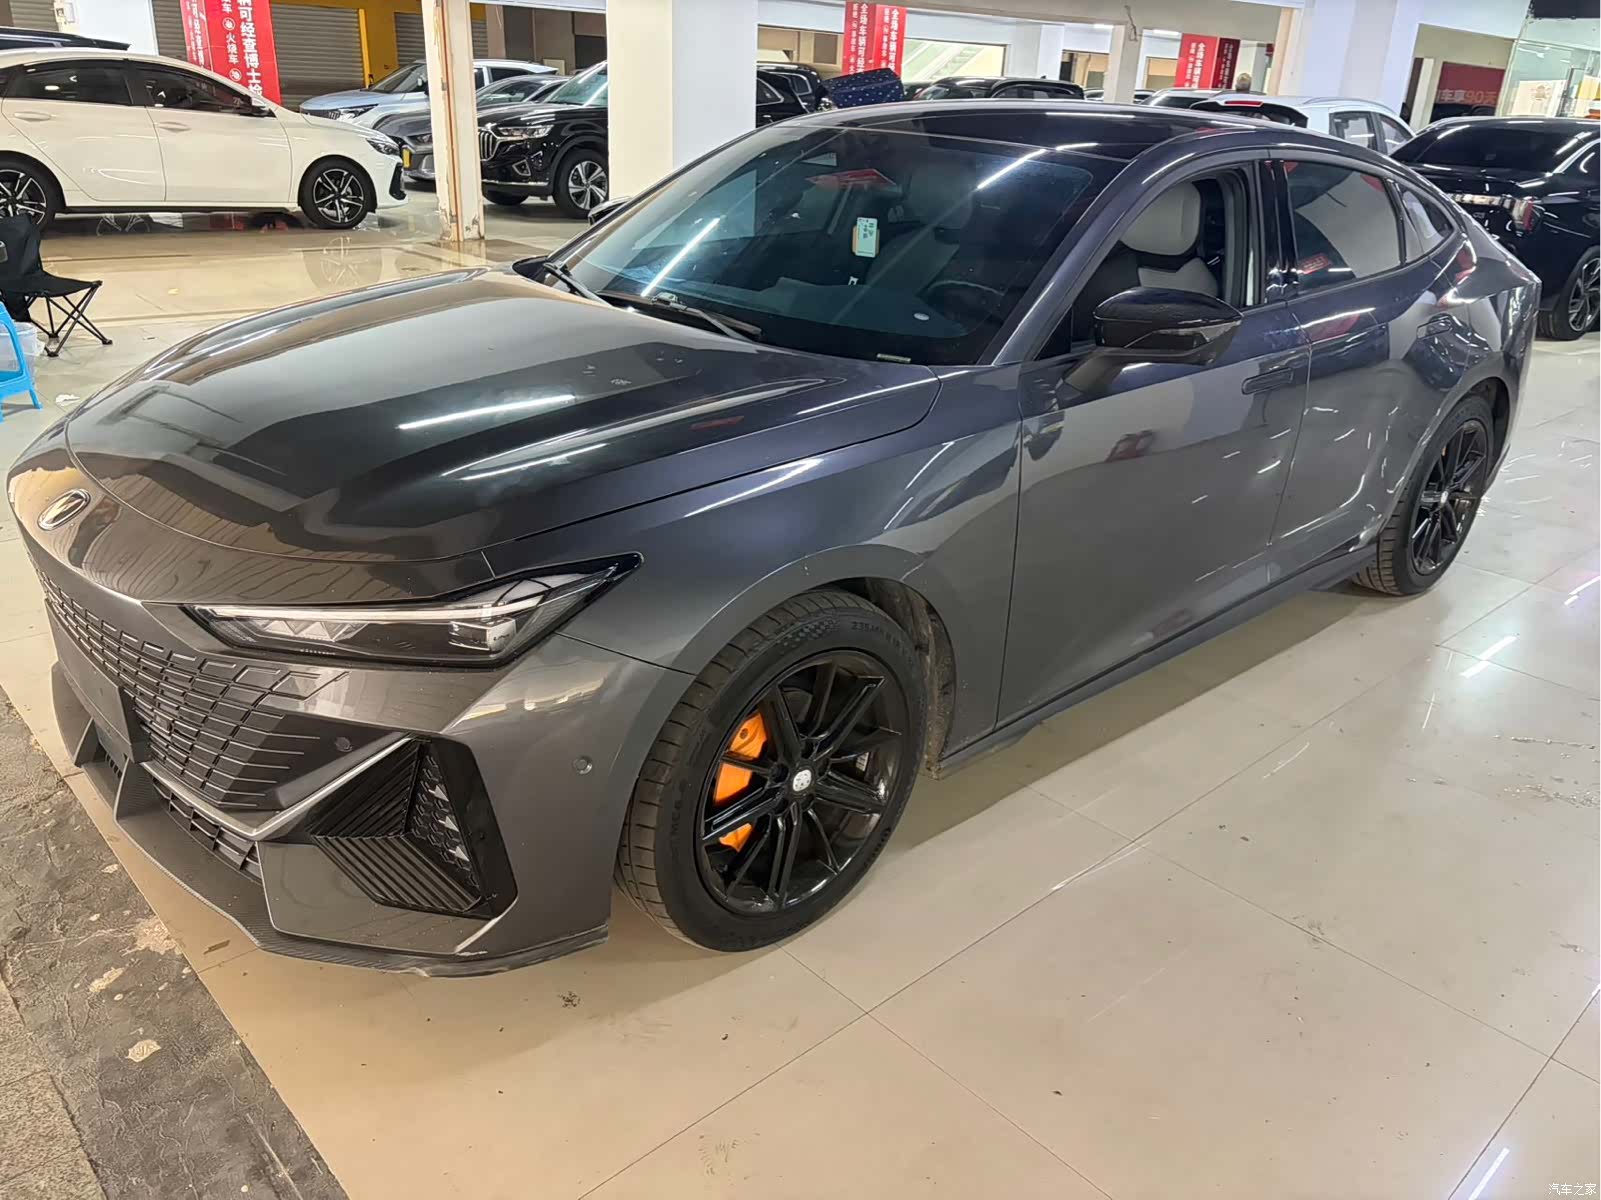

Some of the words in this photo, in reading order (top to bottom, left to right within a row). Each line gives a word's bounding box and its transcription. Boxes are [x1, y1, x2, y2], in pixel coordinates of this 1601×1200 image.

[226, 32, 239, 65] 火烧车
[1438, 89, 1497, 104] 车享90元
